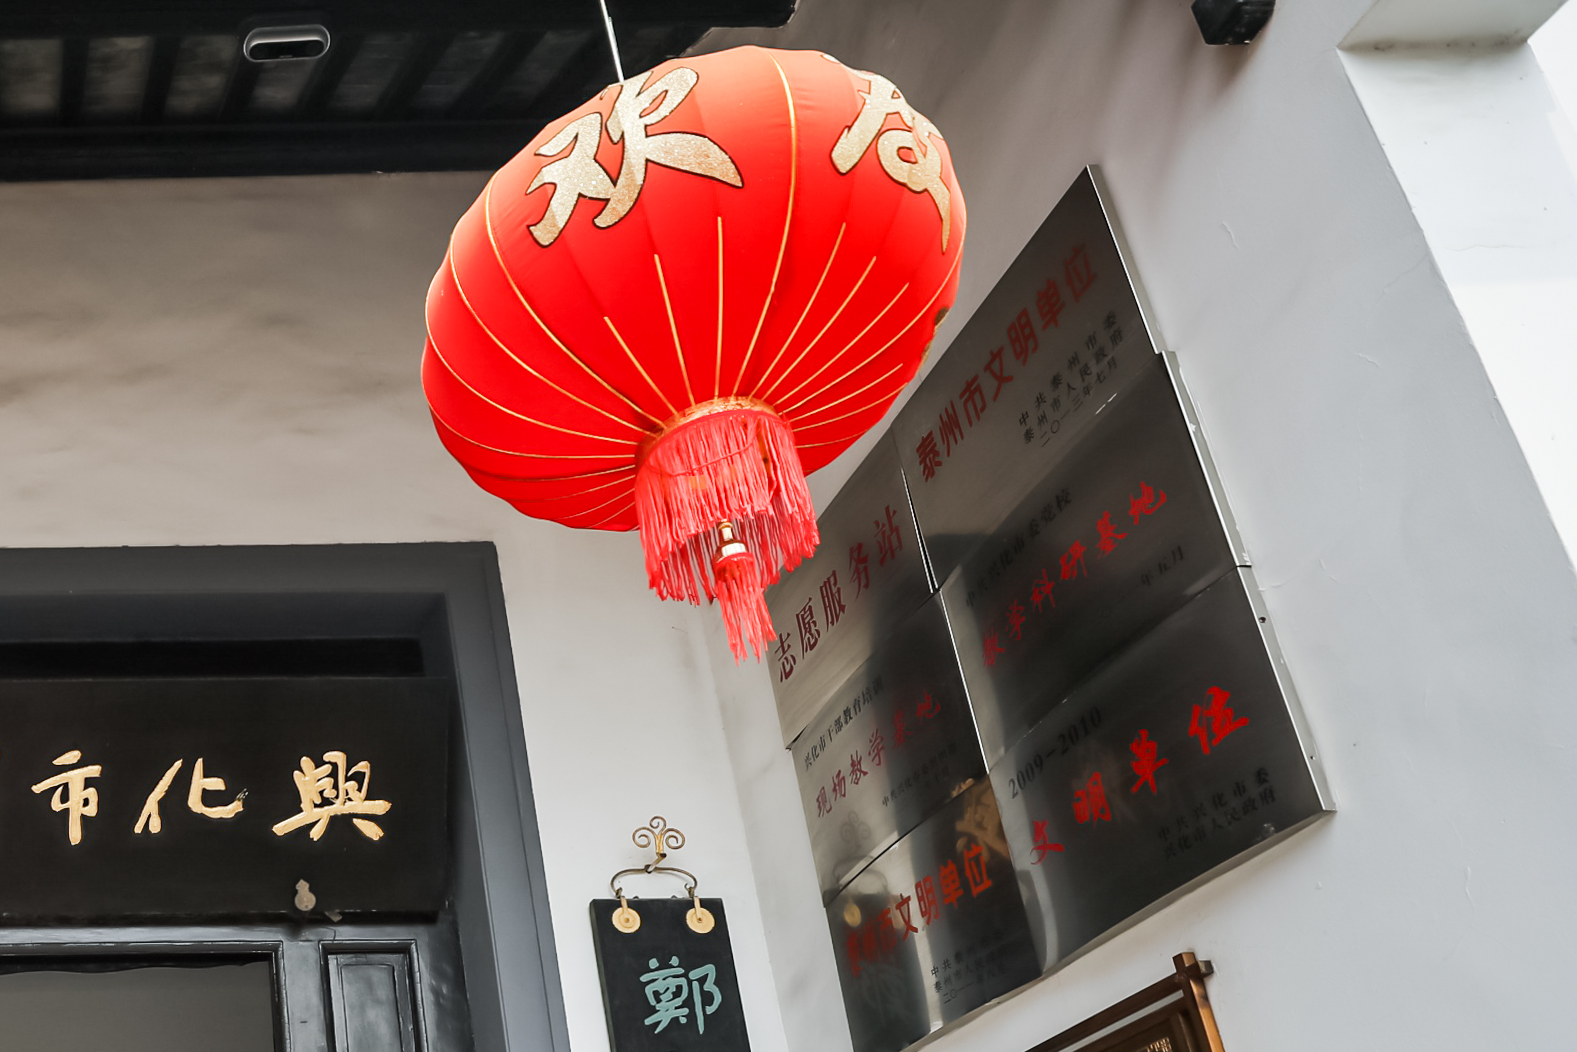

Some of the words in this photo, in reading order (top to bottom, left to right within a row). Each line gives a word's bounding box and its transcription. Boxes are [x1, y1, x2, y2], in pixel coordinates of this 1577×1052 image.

[525, 65, 744, 247] 欢
[915, 242, 1098, 483] 泰州市文明单位
[1018, 310, 1117, 428] 中共泰州市委
[1022, 328, 1123, 444] 泰州市人民政府
[774, 504, 905, 683] 志愿服务站
[815, 689, 941, 818] 现场教学基地
[1030, 686, 1249, 865] 文明单位
